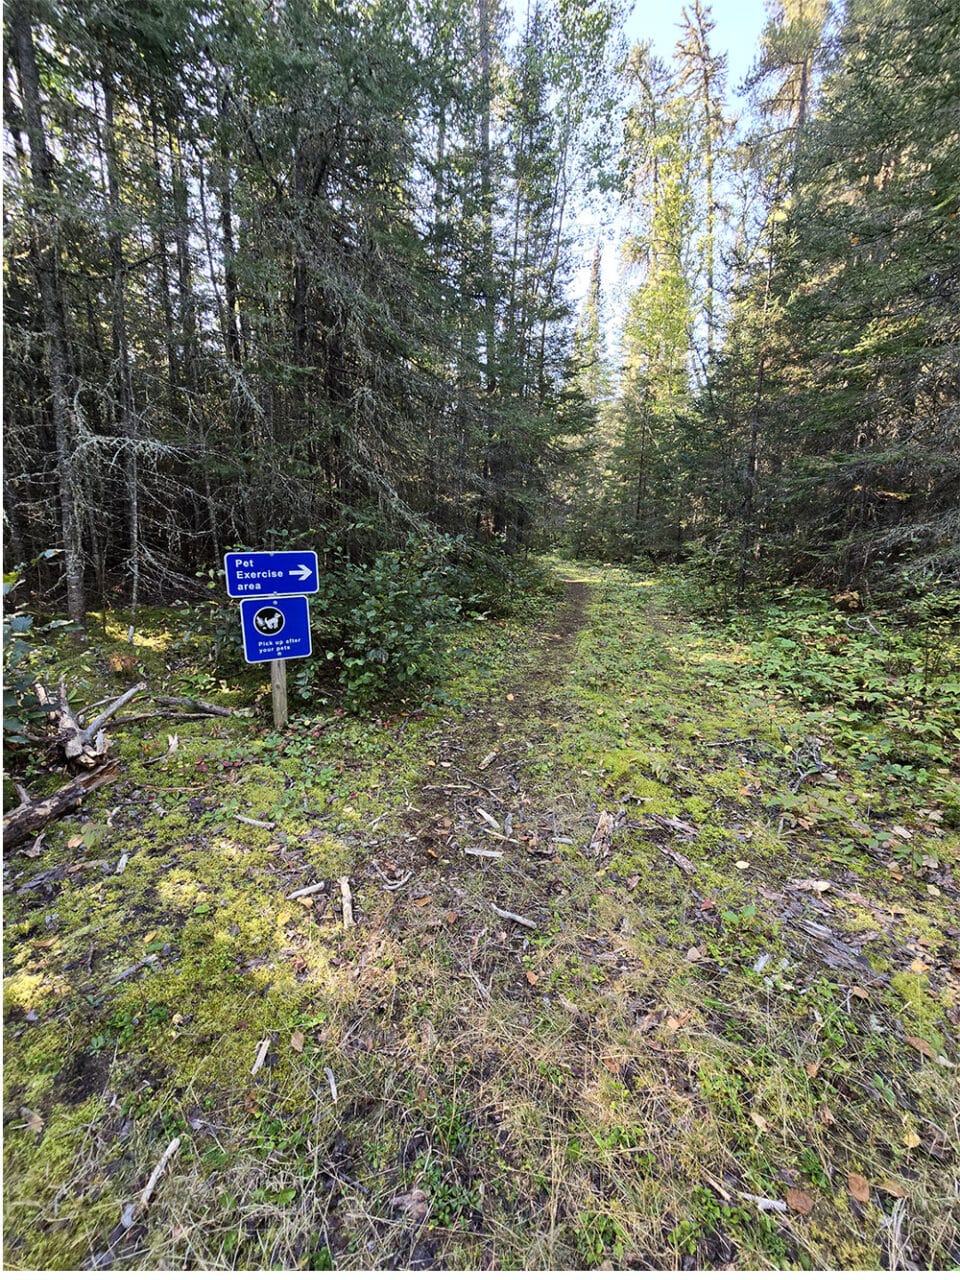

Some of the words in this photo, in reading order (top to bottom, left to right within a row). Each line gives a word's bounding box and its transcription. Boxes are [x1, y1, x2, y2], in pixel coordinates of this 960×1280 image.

[235, 559, 254, 568] Pet
[236, 570, 284, 579] Exercise
[237, 583, 261, 591] area
